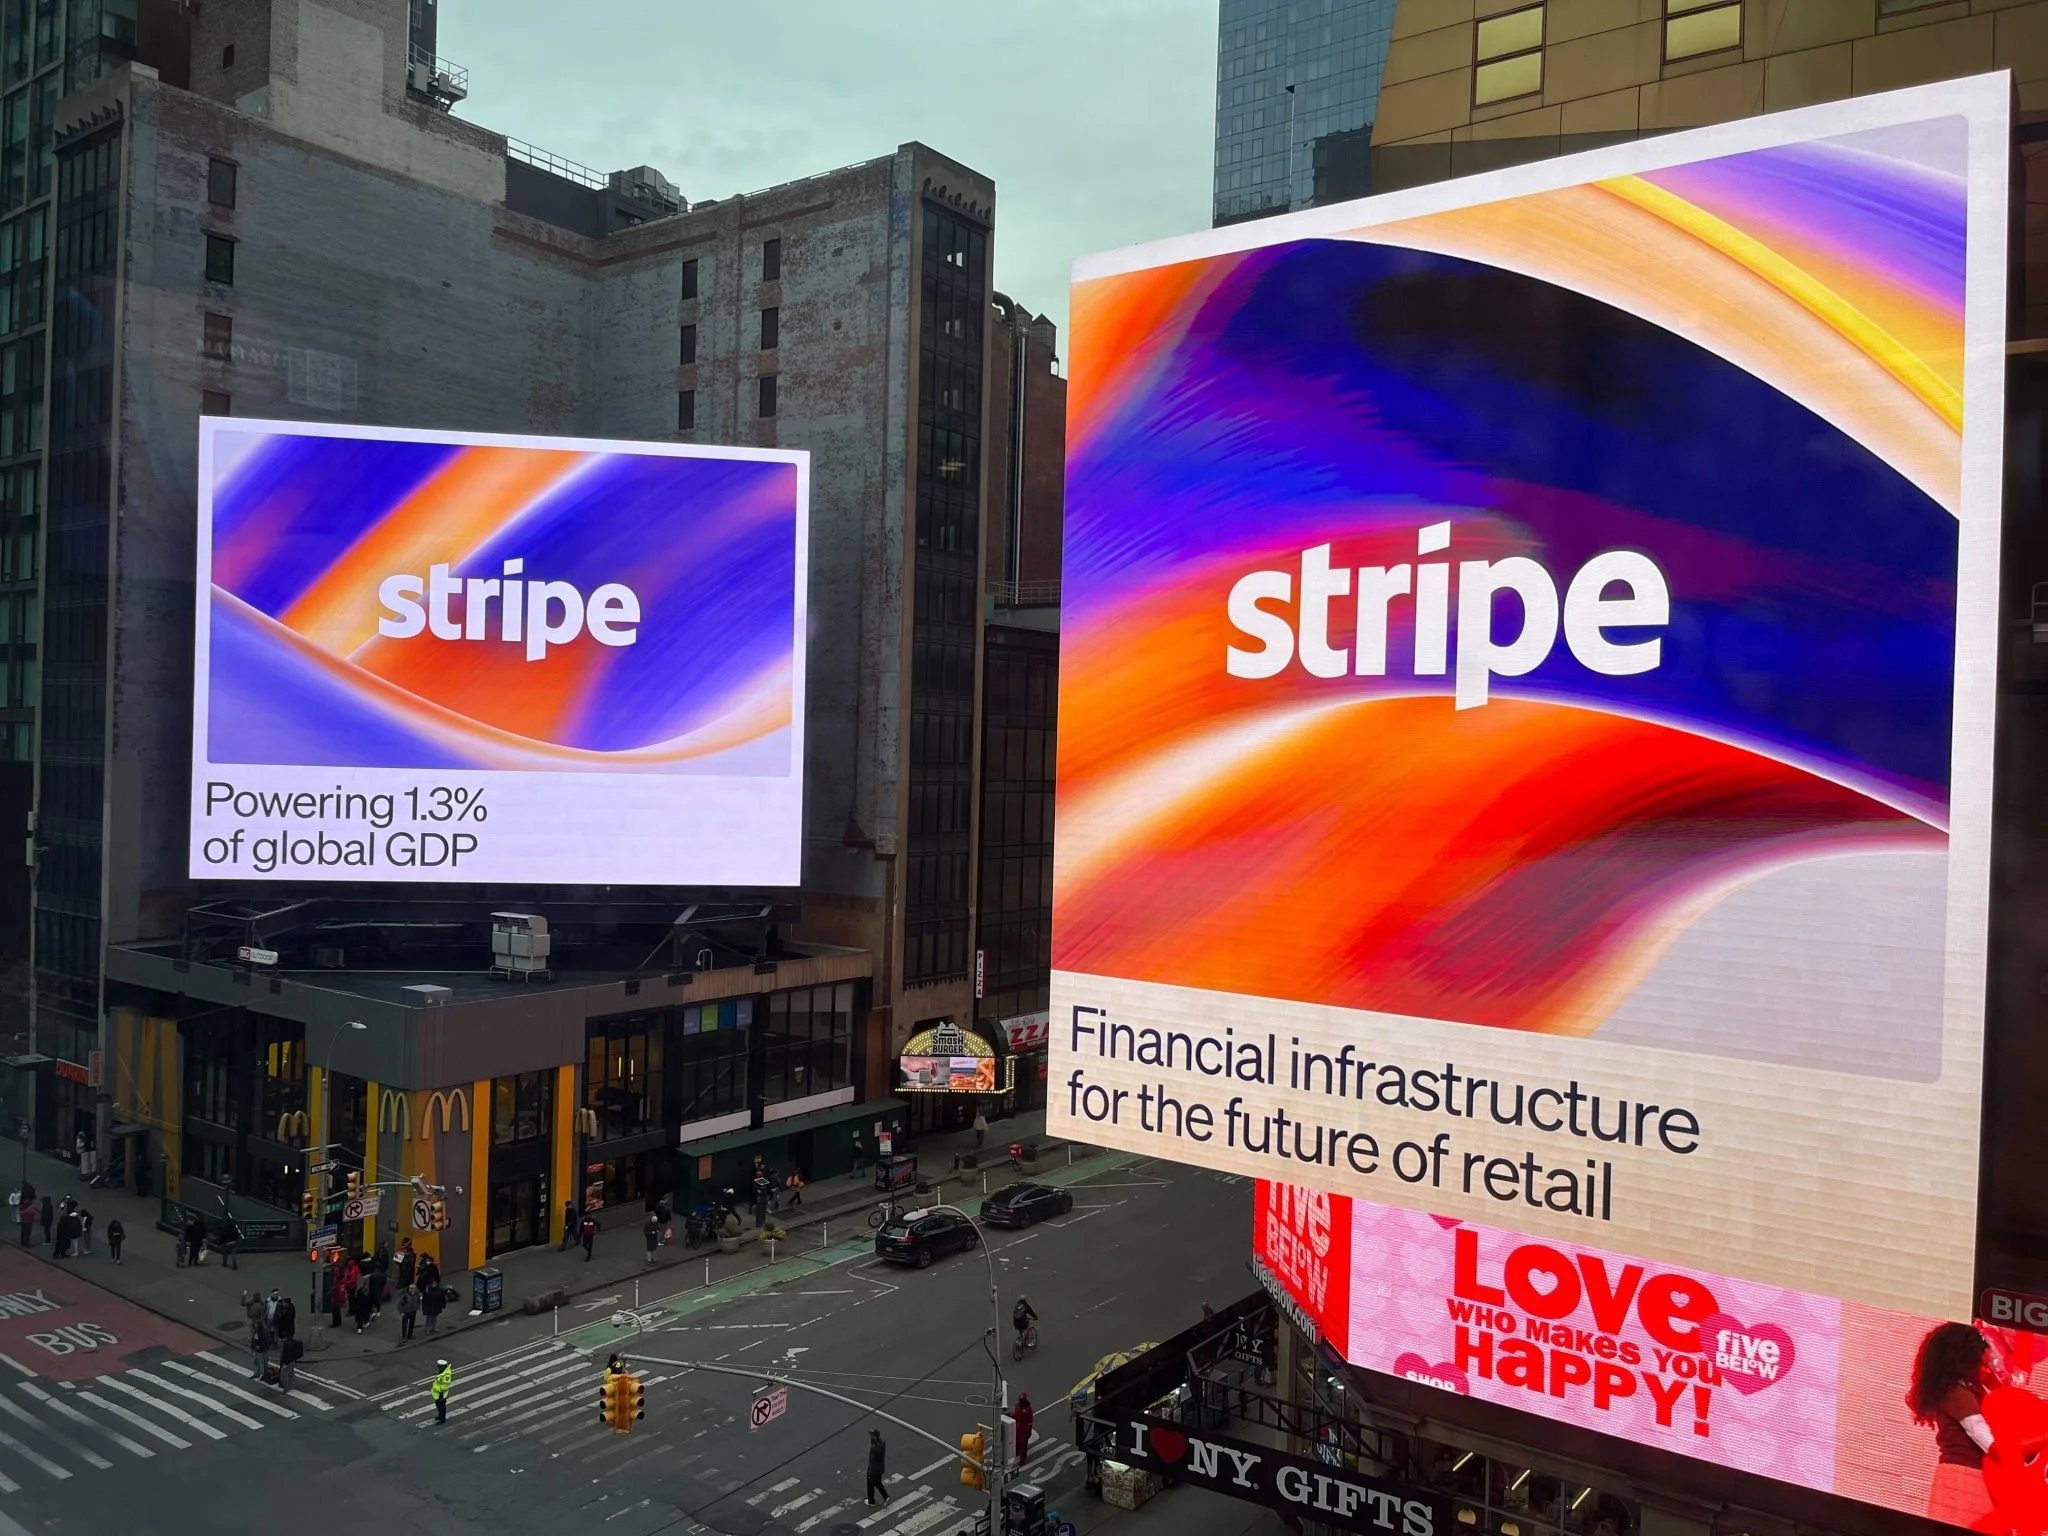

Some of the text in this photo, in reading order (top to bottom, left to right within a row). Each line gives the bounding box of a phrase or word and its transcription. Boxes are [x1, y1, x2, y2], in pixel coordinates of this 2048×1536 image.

[378, 557, 641, 662] stripe
[1226, 520, 1670, 712] stripe
[205, 782, 488, 829] Powering 1.3%
[203, 829, 479, 873] of global GDP
[932, 1045, 964, 1054] BURGER
[1071, 1005, 1700, 1154] Financial infrastructure
[1067, 1069, 1613, 1221] for the future of retail
[0, 1289, 61, 1319] NLY
[1446, 1298, 1516, 1334] WHO
[1992, 1294, 2048, 1327] BIG
[25, 1322, 118, 1356] BUS
[1234, 1351, 1263, 1366] GIFTS
[1130, 1421, 1149, 1458] I
[1187, 1437, 1262, 1489] NY
[1276, 1466, 1434, 1536] GIFTS
